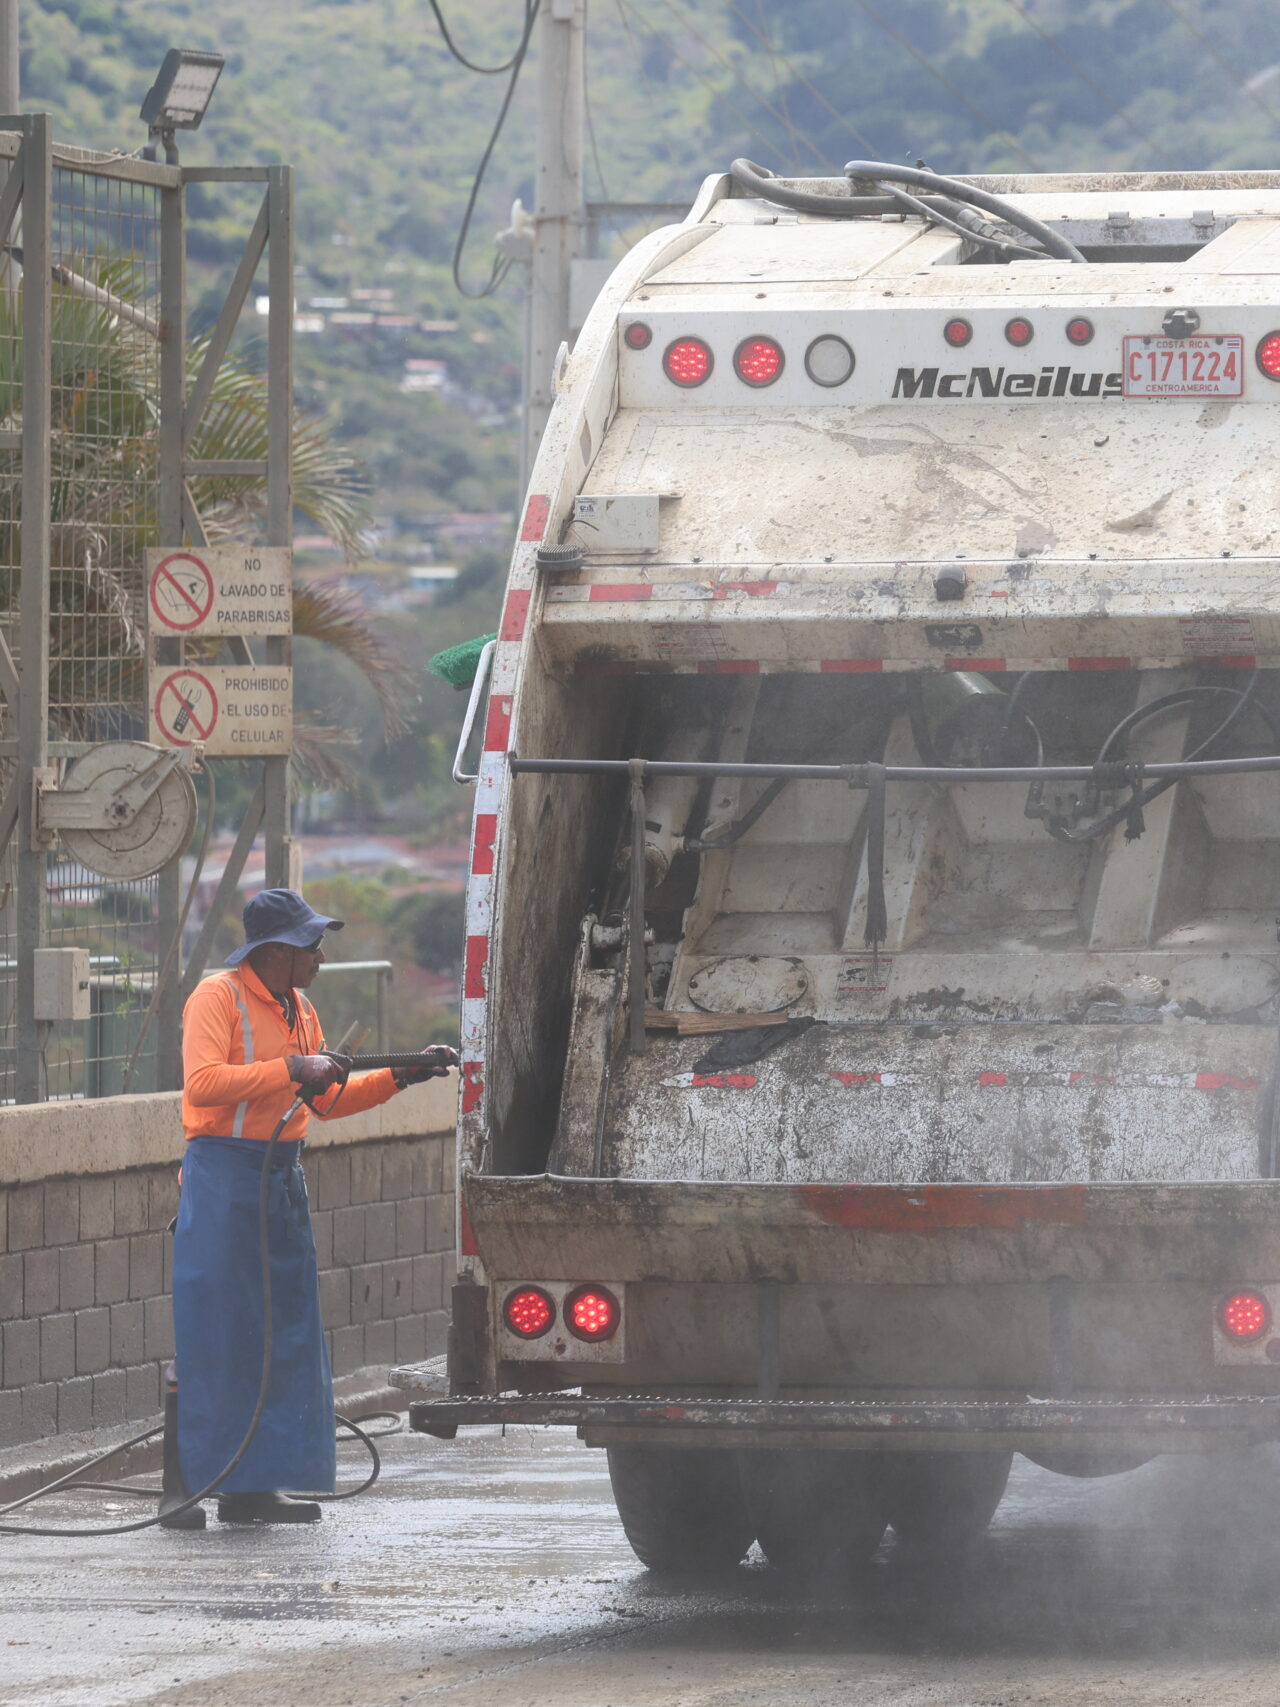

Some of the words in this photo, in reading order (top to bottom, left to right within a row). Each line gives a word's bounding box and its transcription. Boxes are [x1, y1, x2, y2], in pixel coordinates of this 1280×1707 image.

[1156, 340, 1185, 349] COSTA
[1188, 340, 1211, 349] RICA
[1129, 351, 1237, 382] C171224
[1145, 384, 1220, 393] CENTROAMERICA
[244, 558, 261, 572] NO
[220, 584, 267, 598] LAVADO
[270, 584, 286, 597] DE
[217, 610, 290, 623] PARABRISAS
[225, 678, 289, 691] PROHIBIDO
[227, 704, 241, 717] EL
[244, 704, 269, 717] USO
[272, 704, 288, 717] DE
[231, 729, 284, 743] CELULAR
